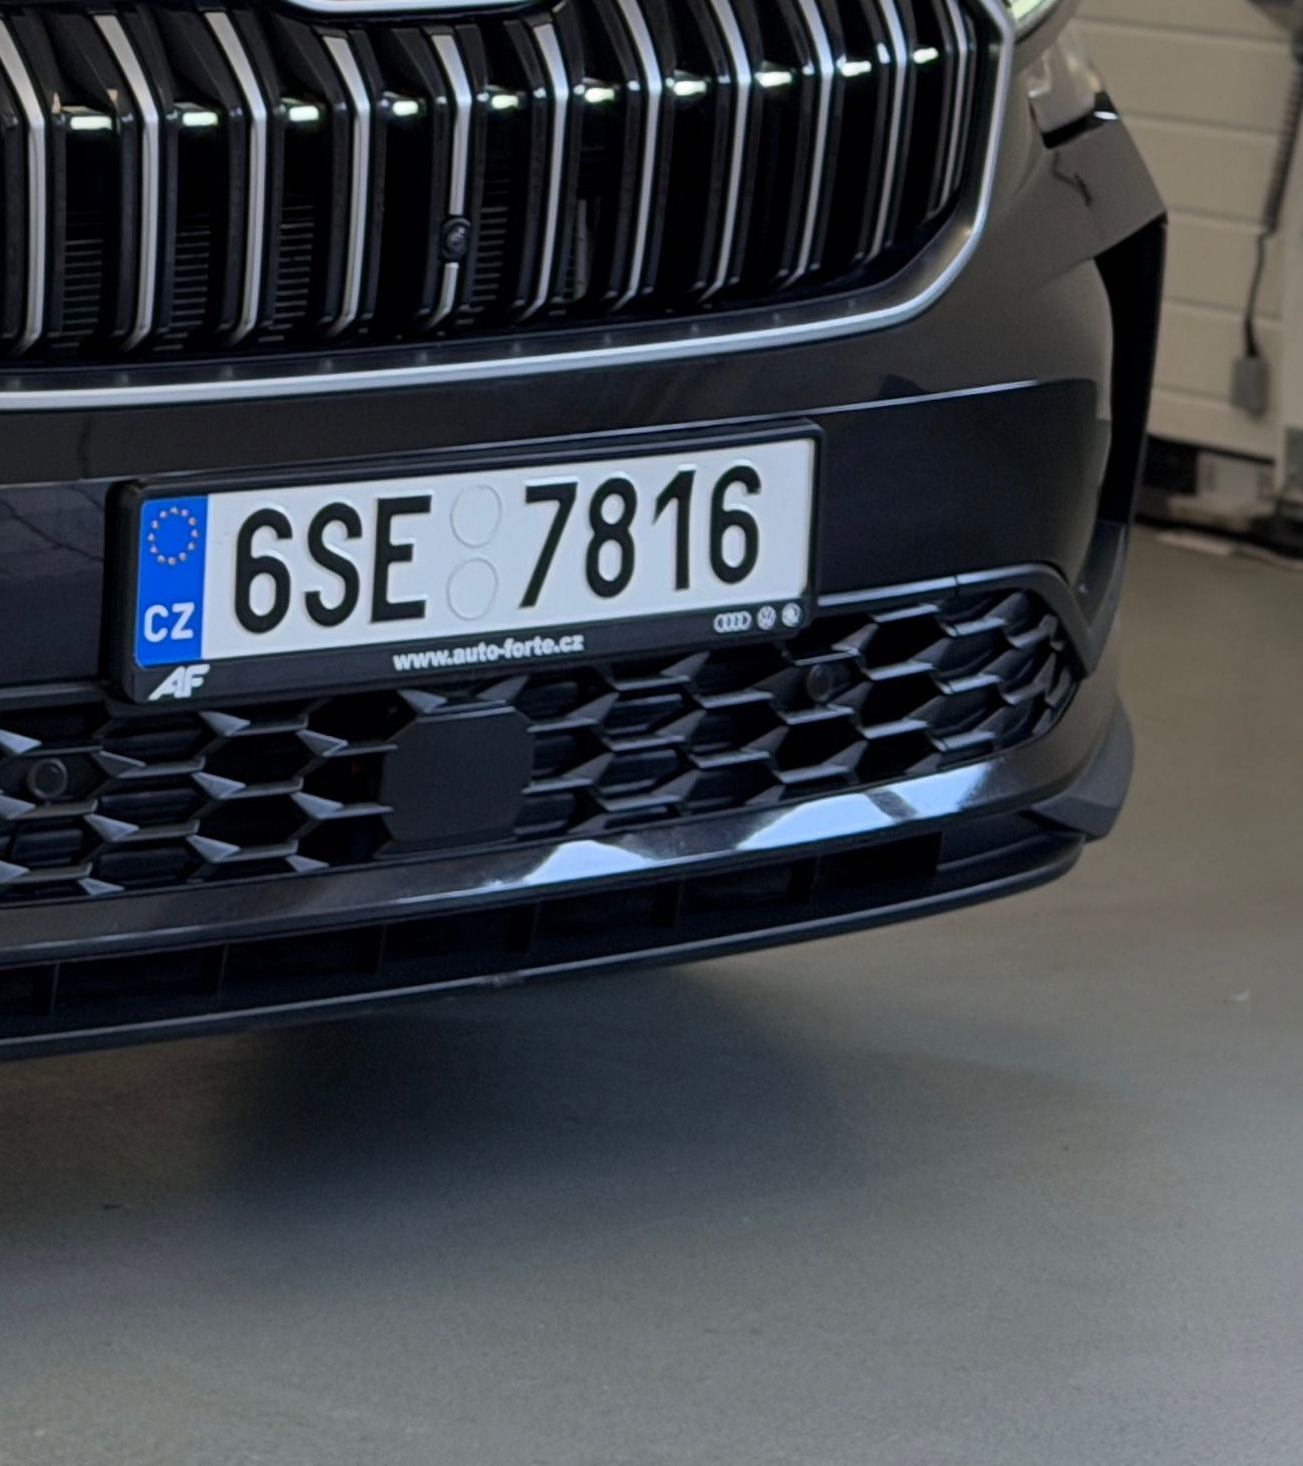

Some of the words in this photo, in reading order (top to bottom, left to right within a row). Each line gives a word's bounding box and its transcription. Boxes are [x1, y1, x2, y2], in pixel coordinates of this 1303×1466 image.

[234, 494, 433, 634] 6SE
[520, 465, 761, 608] 7816
[143, 601, 195, 643] CZ
[393, 634, 585, 672] www.auto-forte.cz
[148, 663, 211, 701] AF
